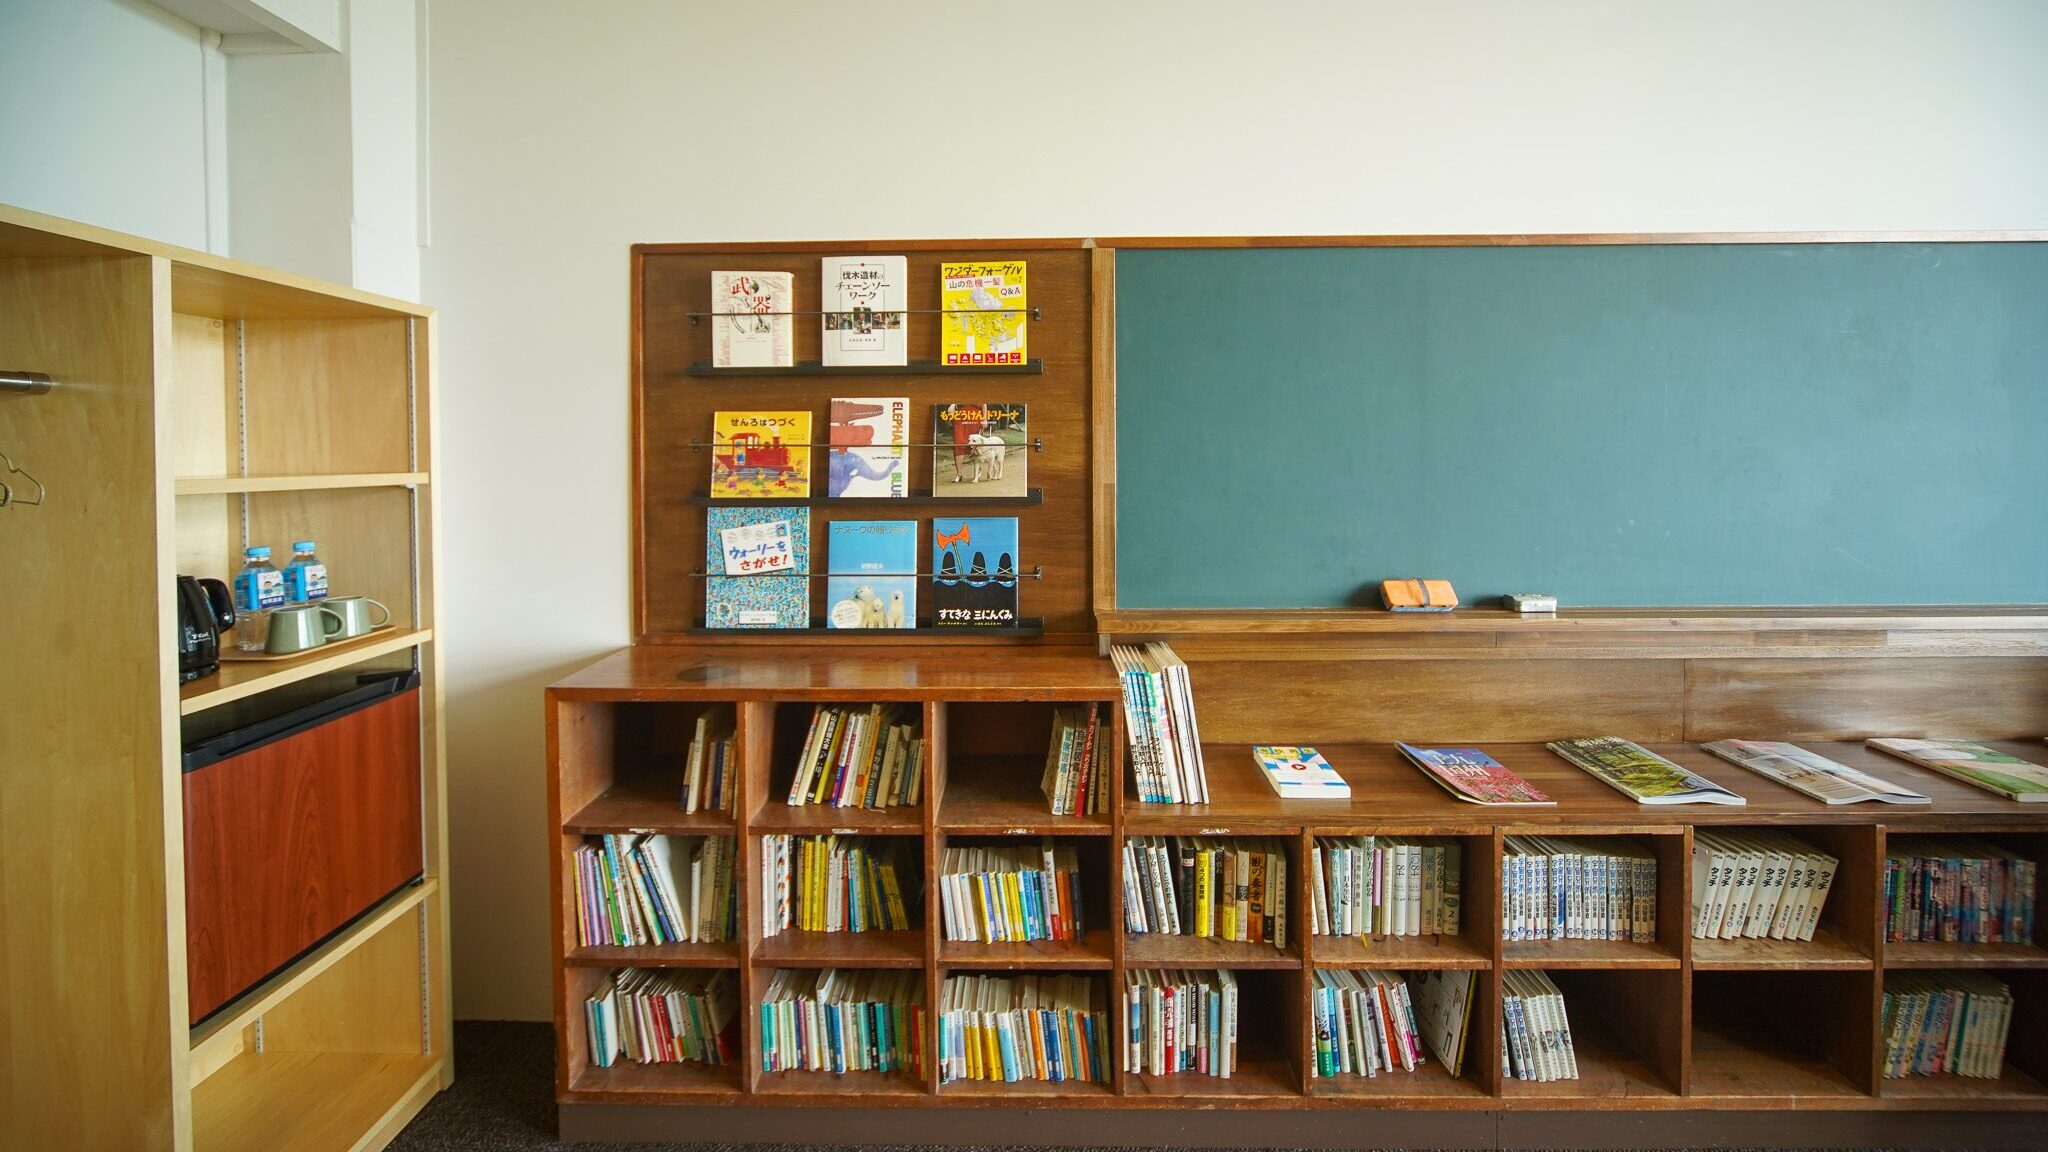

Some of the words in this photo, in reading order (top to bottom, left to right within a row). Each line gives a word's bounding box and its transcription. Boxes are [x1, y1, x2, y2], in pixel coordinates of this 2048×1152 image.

[843, 270, 884, 280] 伐木造材の
[945, 263, 1022, 276] ワンダーフォーゲル
[835, 281, 890, 291] チェーンソー
[949, 277, 1000, 289] 山の危機一髪
[1000, 287, 1020, 296] Q&A
[732, 277, 771, 315] 武器
[849, 291, 876, 300] ワーク
[731, 418, 795, 427] せんろはつづく
[892, 402, 903, 457] ELEPHANT
[729, 541, 786, 560] ウォーリーを
[1396, 853, 1405, 876] 184
[1411, 853, 1421, 876] 1Q84
[1160, 854, 1172, 904] スプートニクの恋人
[1251, 857, 1262, 901] 獣の奏者
[1709, 867, 1719, 887] タッチ
[1721, 867, 1733, 887] タッチ
[1736, 867, 1748, 887] タッチ
[1747, 867, 1758, 886] タッチ
[1763, 868, 1775, 887] タッチ
[1775, 867, 1786, 887] タッチ
[1790, 869, 1803, 888] タッチ
[1804, 869, 1816, 888] タッチ
[1818, 871, 1831, 890] タッチ
[1507, 1001, 1518, 1034] 宇宙兄弟
[1514, 1000, 1527, 1034] 宇宙兄弟
